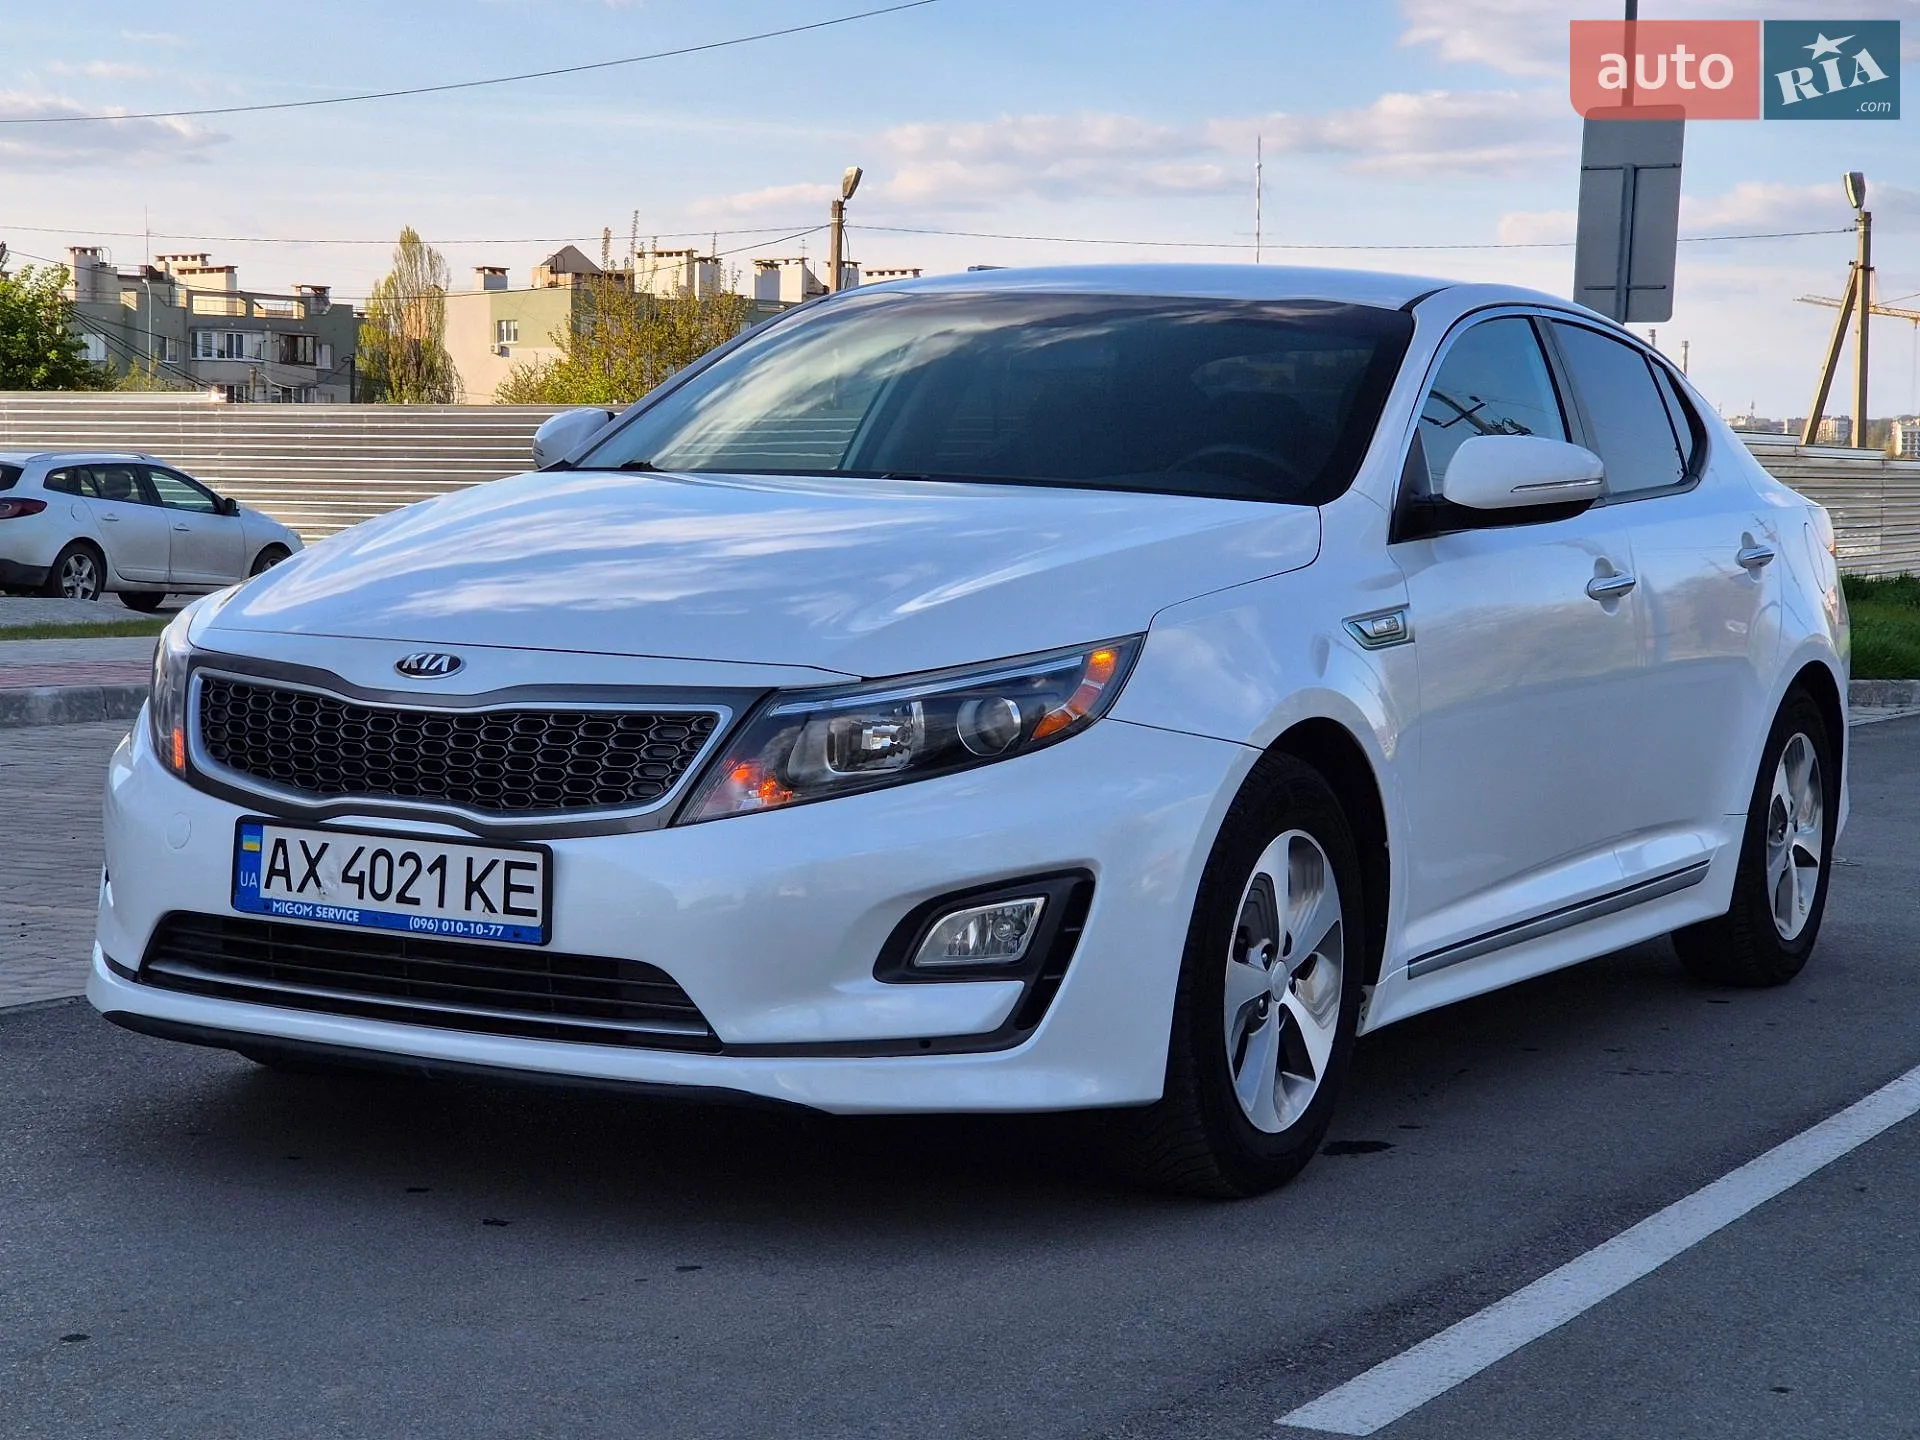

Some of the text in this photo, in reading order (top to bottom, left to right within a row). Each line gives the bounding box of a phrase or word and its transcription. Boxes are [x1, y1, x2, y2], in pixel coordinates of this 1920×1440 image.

[401, 653, 450, 672] KIA
[240, 870, 258, 889] UA
[263, 838, 538, 917] AX 4021 KE
[315, 906, 360, 922] SERVICE
[409, 916, 504, 937] (096) 010-10-77
